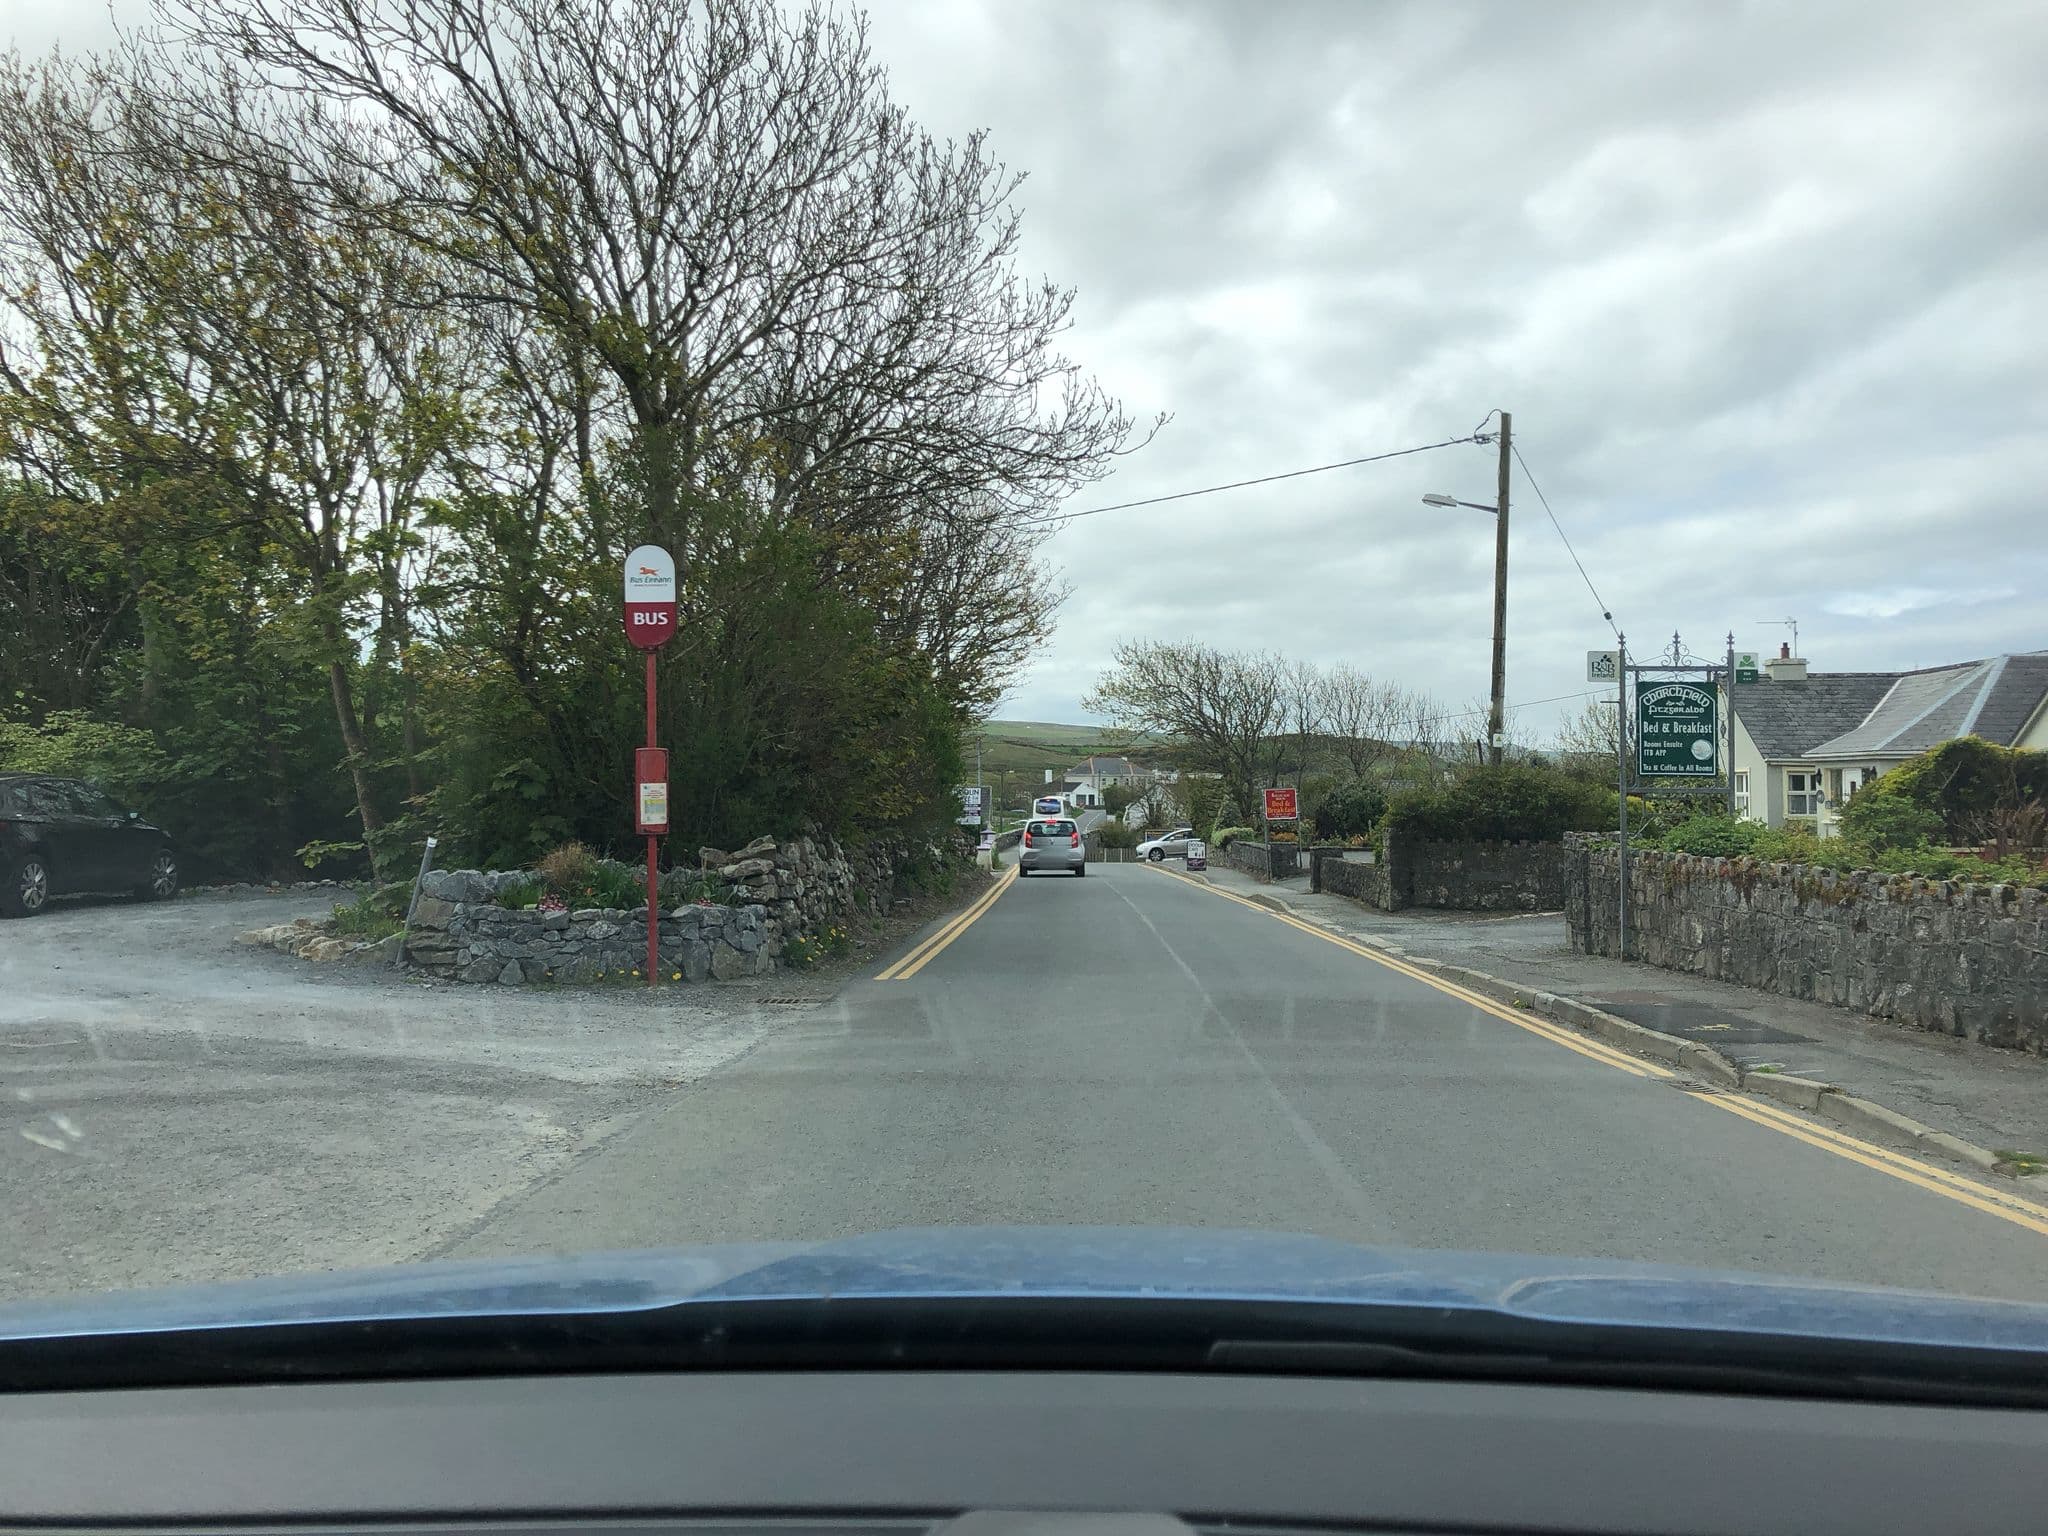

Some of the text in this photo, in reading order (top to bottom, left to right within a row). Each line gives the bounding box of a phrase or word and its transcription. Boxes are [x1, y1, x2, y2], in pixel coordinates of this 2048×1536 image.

[633, 612, 668, 625] BUS
[1592, 661, 1615, 672] B&B
[1642, 686, 1710, 707] Churchfield
[1643, 721, 1713, 734] Bed & Breakfast
